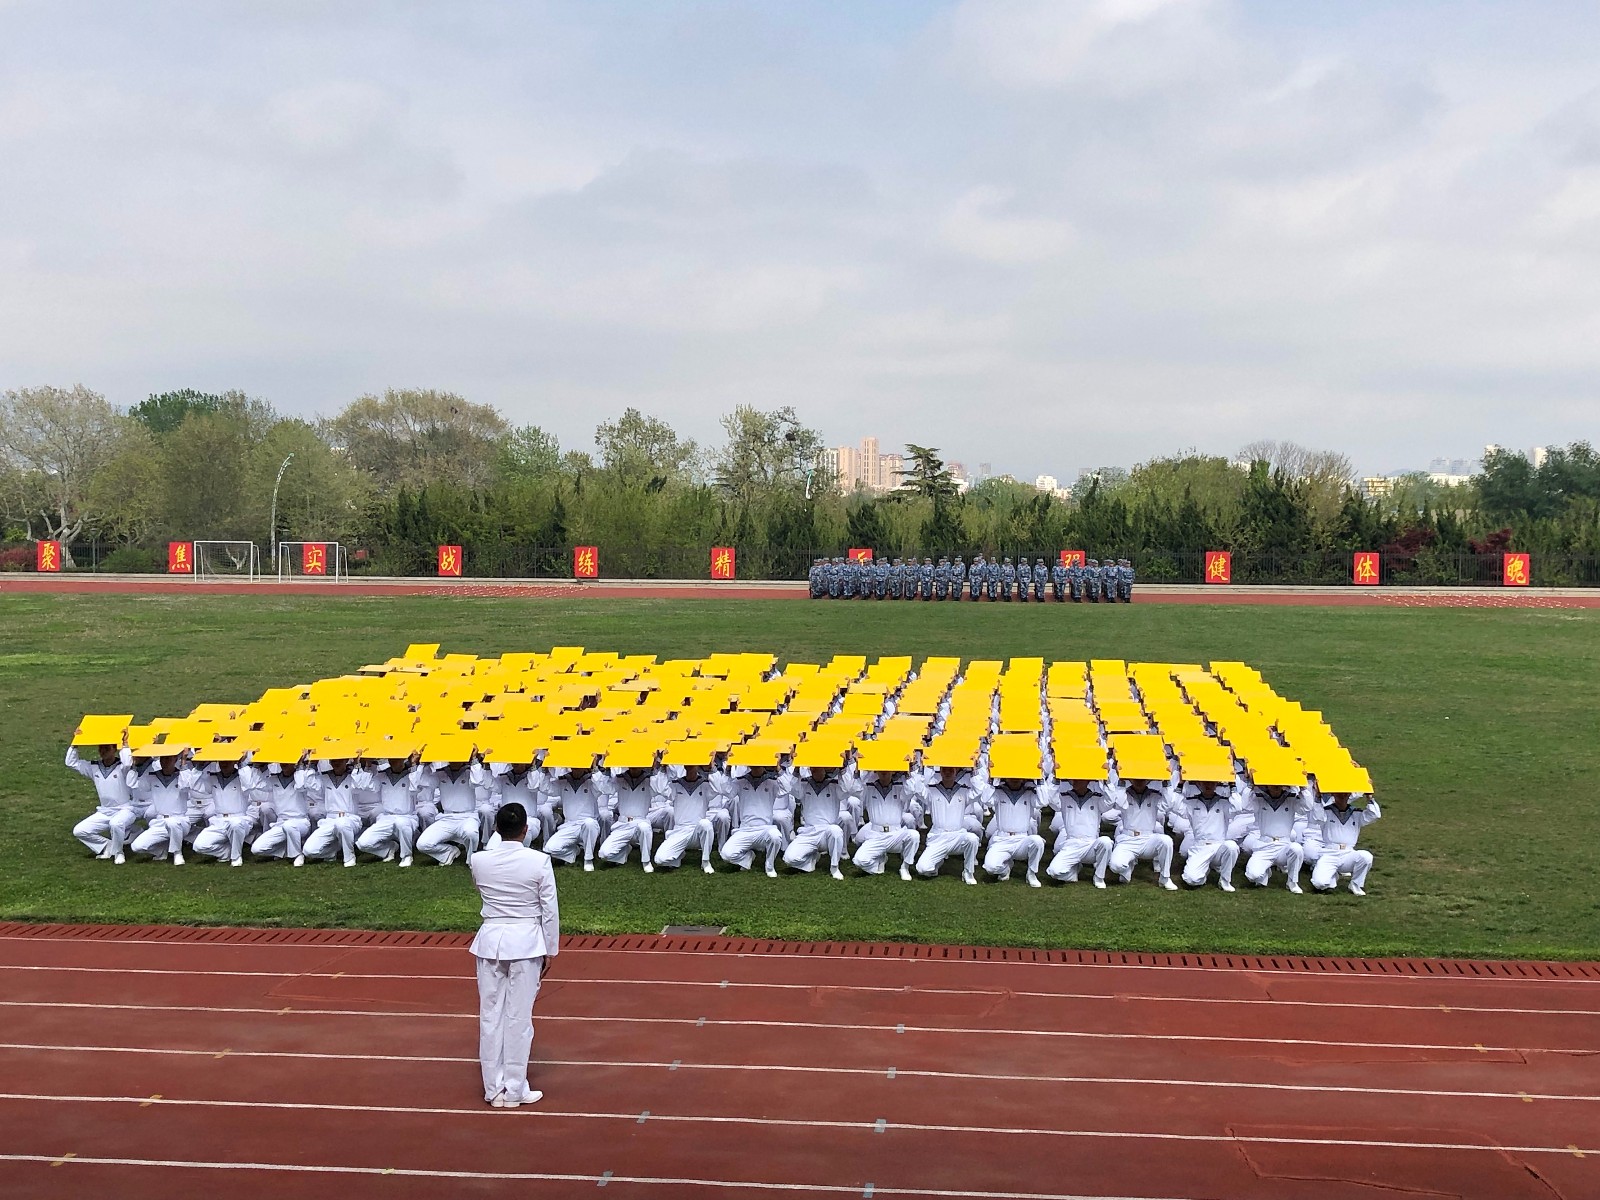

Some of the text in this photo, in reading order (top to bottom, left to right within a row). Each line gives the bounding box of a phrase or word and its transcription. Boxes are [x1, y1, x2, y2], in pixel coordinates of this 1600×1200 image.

[42, 542, 56, 570] 聚
[172, 544, 191, 572] 焦
[306, 546, 323, 573] 实
[441, 546, 460, 575] 战
[579, 548, 594, 575] 练
[715, 550, 732, 577] 精
[1208, 554, 1228, 581] 健
[1357, 555, 1377, 582] 体
[1508, 557, 1526, 583] 魄
